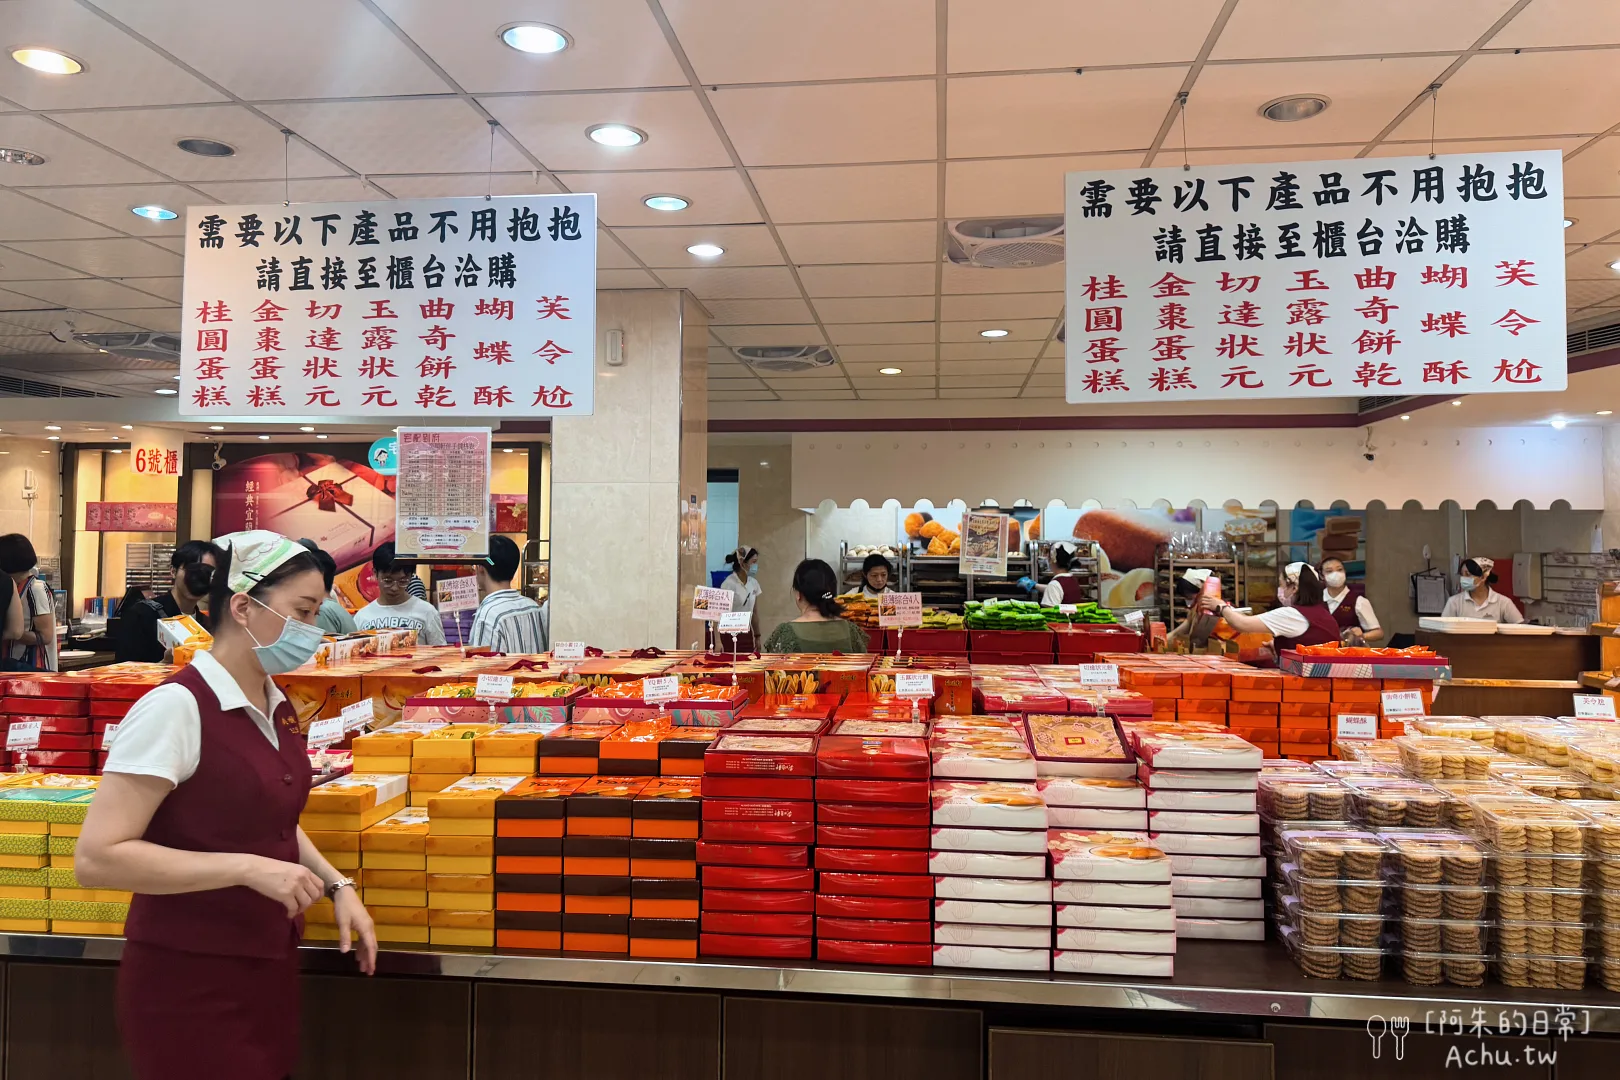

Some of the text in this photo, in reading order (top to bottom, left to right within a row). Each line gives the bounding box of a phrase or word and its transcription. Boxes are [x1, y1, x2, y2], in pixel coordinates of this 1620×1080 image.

[198, 205, 582, 249] 需要以下產品不用抱抱
[1080, 161, 1549, 219] 需要以下產品不用抱抱
[1153, 214, 1471, 264] 請直接至櫃台洽購
[256, 252, 517, 291] 請直接至櫃台洽購
[1352, 265, 1402, 388] 曲奇餅乾
[1420, 263, 1472, 386] 蝴蝶酥
[1490, 259, 1543, 385] 芙令尬
[192, 299, 233, 408] 桂圓蛋糕
[246, 299, 288, 408] 金棗蛋糕
[303, 299, 342, 407] 切達狀元
[358, 299, 398, 408] 玉露狀元
[415, 298, 457, 408] 曲奇餅乾
[473, 297, 514, 408] 蝴蝶酥
[532, 295, 573, 408] 芙令尬
[1081, 275, 1130, 394] 桂圓蛋糕
[1148, 272, 1197, 393] 金棗蛋糕
[1215, 272, 1265, 389] 切達狀元
[1283, 269, 1333, 388] 玉露狀元
[136, 448, 178, 475] 6號櫃
